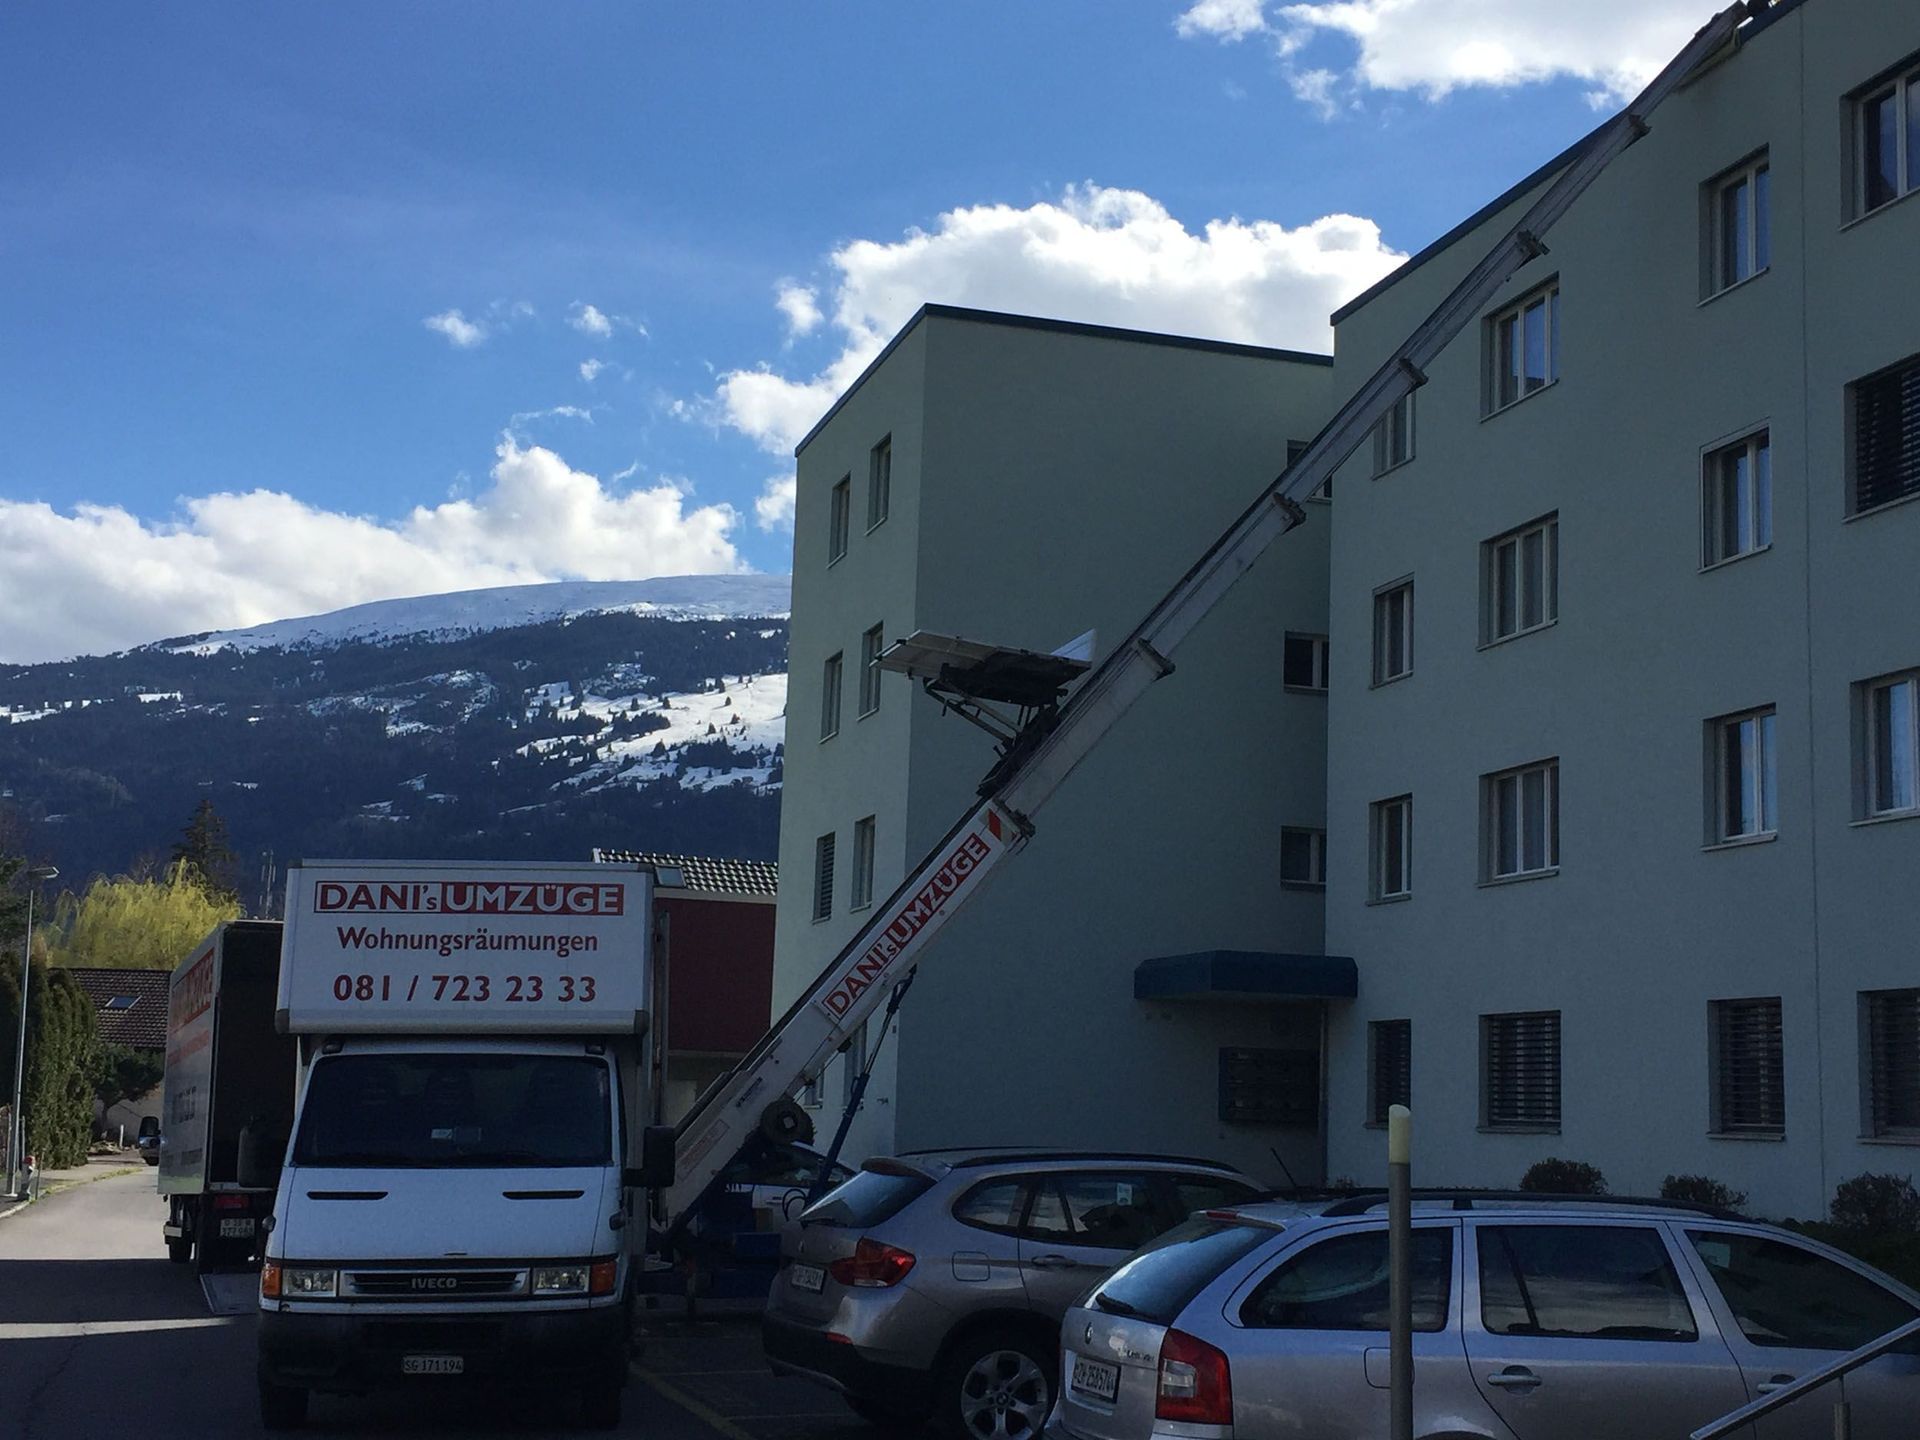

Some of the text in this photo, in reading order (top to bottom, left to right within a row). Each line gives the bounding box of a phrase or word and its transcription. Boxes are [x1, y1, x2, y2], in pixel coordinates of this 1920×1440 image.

[445, 884, 619, 914] UMZÜGE
[889, 837, 986, 948] UMZÜGE
[336, 926, 599, 958] Wohnungsräumungen
[333, 974, 391, 1002] 081
[431, 974, 490, 1002] 723
[505, 975, 544, 1003] 23
[557, 976, 597, 1003] 33
[411, 1277, 457, 1289] IVECO
